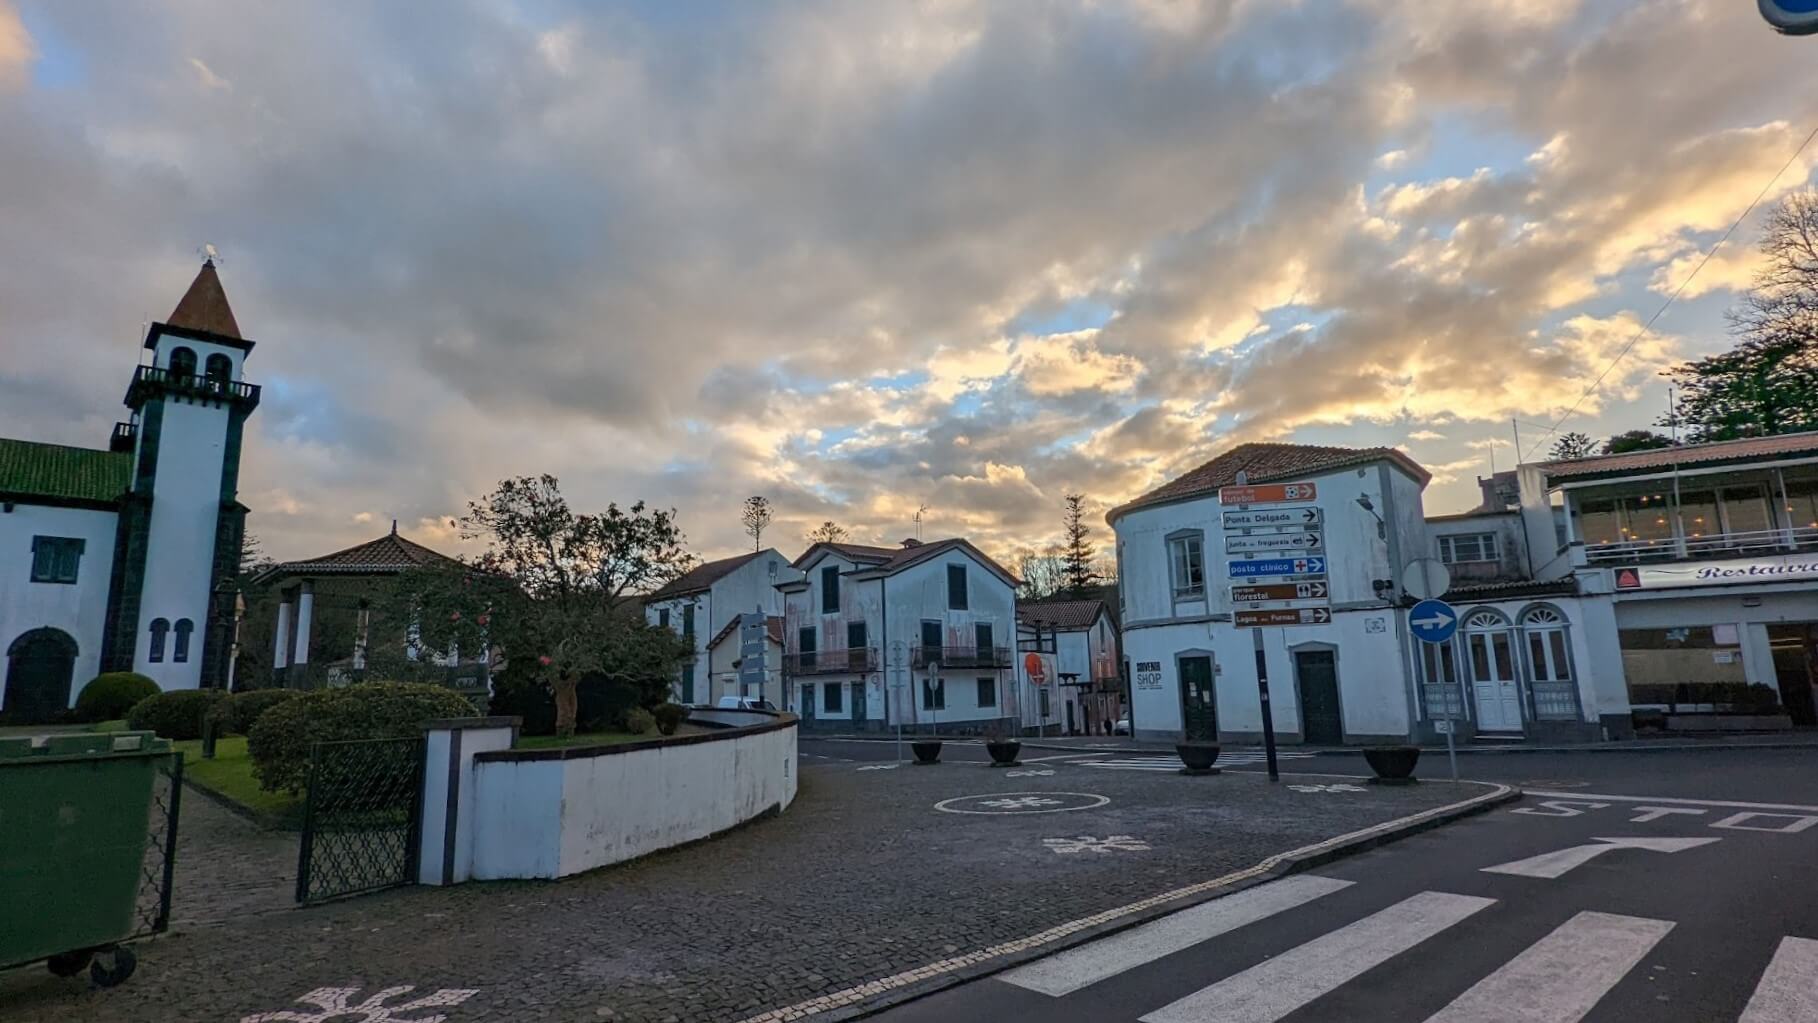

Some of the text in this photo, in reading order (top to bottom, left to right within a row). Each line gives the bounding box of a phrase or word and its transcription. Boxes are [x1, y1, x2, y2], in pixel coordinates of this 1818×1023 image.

[1223, 494, 1255, 503] futebol
[1255, 513, 1290, 523] Delgada
[1229, 541, 1247, 549] junta
[1257, 538, 1289, 547] freguesia
[1231, 565, 1256, 574] posto
[1234, 592, 1269, 601] florestal
[1236, 615, 1258, 624] Lagoa
[1270, 613, 1296, 621] Furnas
[1137, 673, 1162, 685] SHOP
